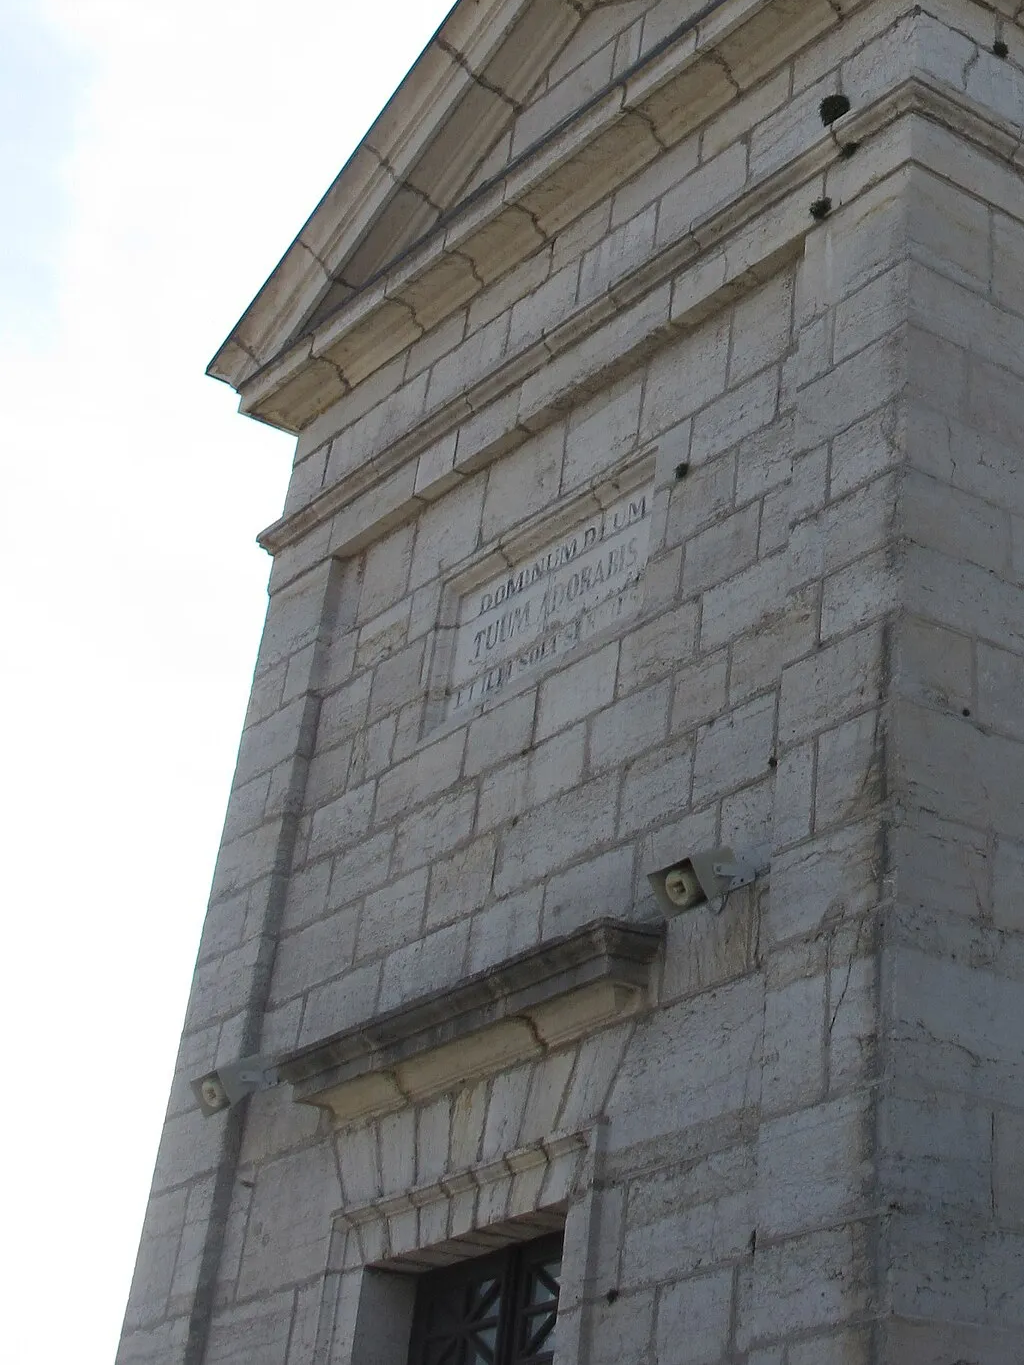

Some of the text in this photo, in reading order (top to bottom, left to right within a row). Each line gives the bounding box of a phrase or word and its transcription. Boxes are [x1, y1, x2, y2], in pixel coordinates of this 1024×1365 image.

[473, 538, 638, 659] TUUM ADORABIS
[479, 537, 578, 616] DOMINUM
